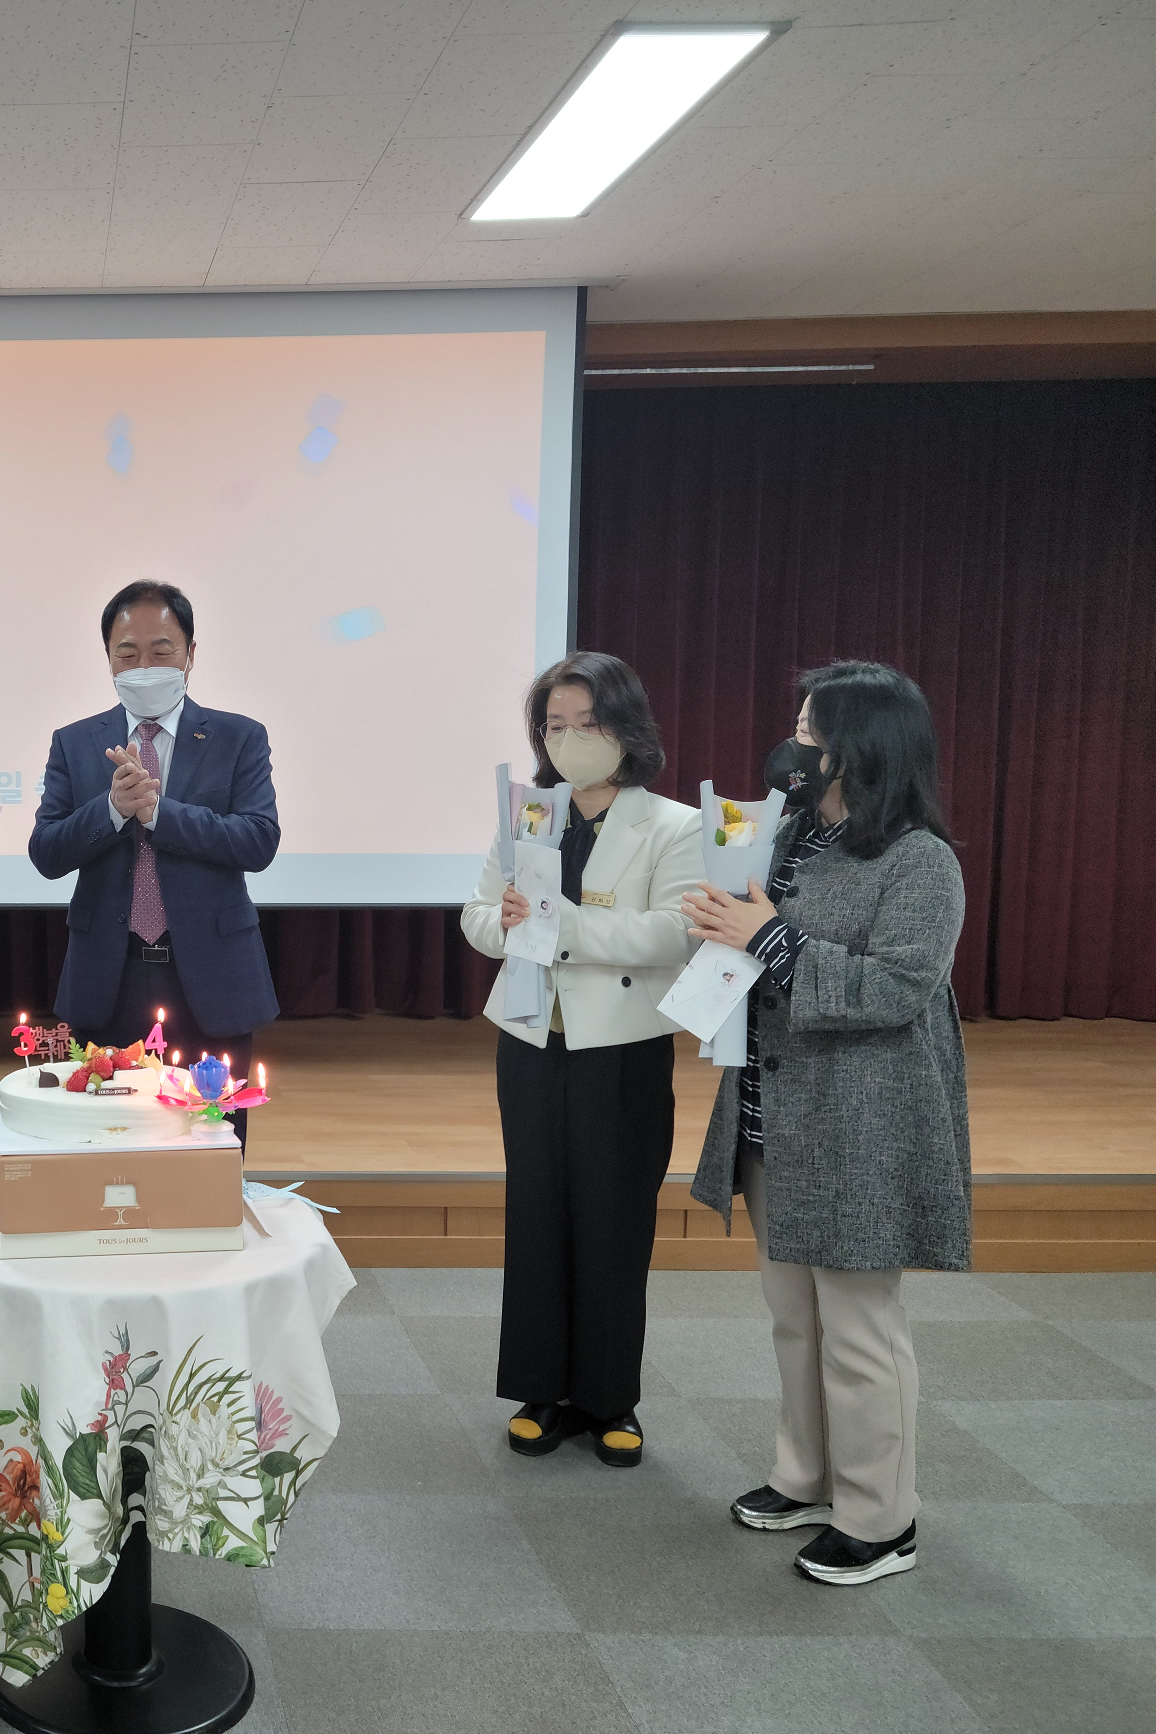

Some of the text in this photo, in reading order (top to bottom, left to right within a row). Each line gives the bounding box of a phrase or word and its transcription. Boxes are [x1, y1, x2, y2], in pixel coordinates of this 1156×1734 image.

[11, 1025, 35, 1056] 3
[145, 1023, 167, 1054] 4
[125, 1236, 149, 1245] JOURS
